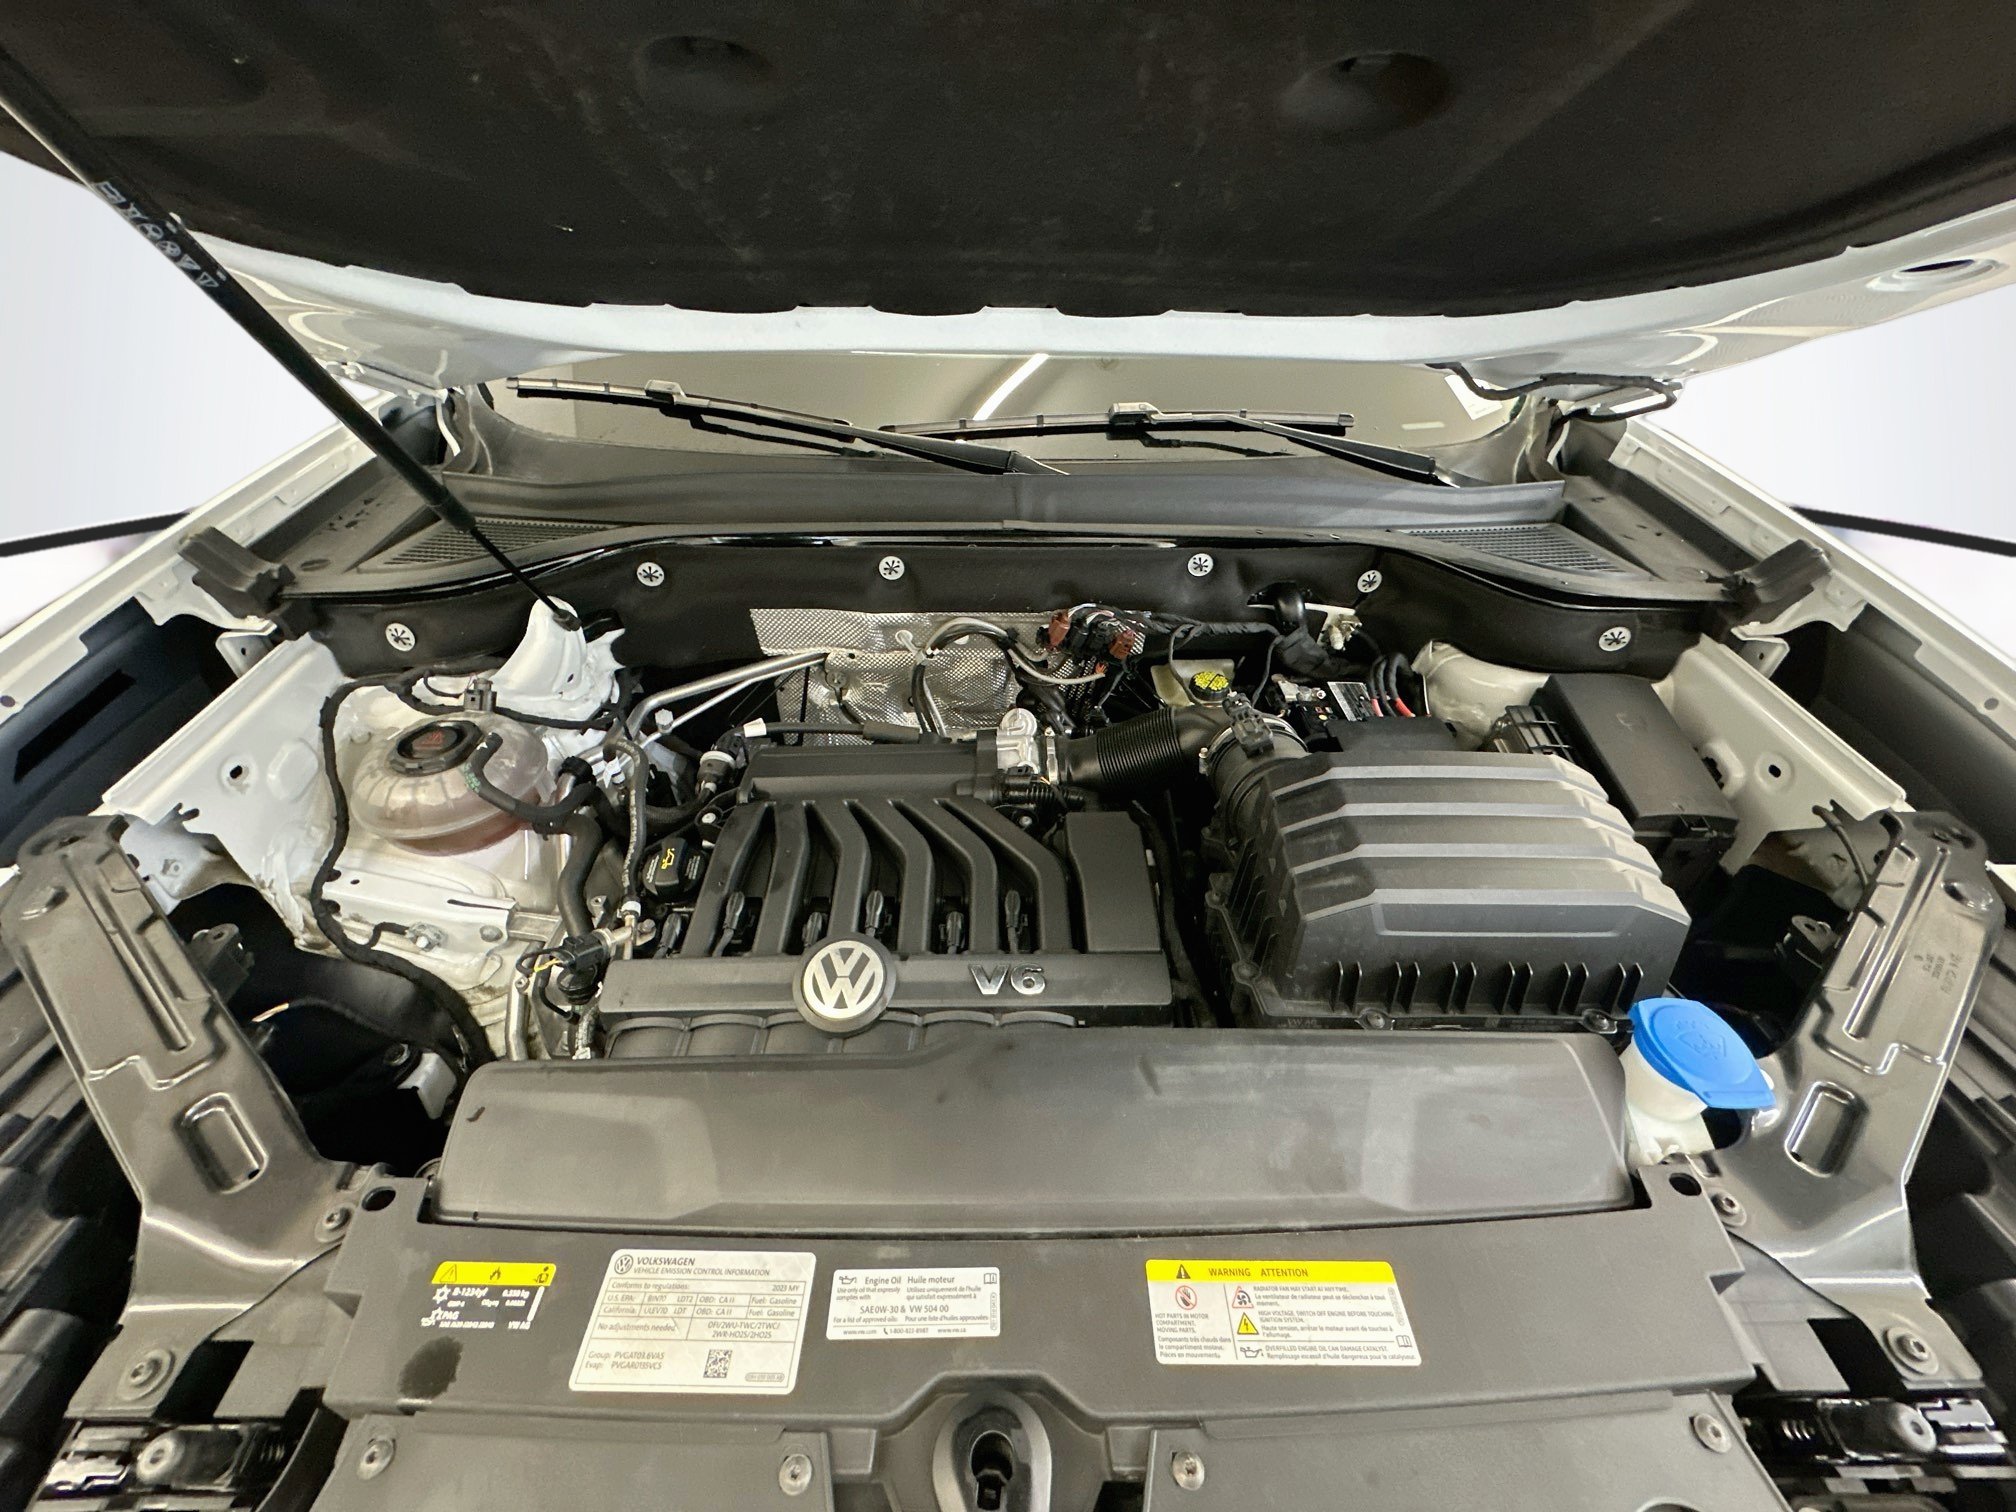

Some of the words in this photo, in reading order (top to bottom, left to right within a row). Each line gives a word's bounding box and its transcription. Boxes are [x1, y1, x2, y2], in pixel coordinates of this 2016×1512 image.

[803, 940, 884, 1019] VW
[968, 962, 1046, 995] V6
[637, 1257, 696, 1266] VOLKSWAGEN
[661, 1267, 691, 1275] EMISSION
[1208, 1267, 1251, 1277] WARNING
[1261, 1268, 1309, 1277] ATTENTION
[865, 1276, 889, 1286] Engine
[891, 1276, 901, 1284] Oil
[907, 1276, 927, 1284] Huile
[928, 1276, 955, 1284] moteur
[612, 1281, 642, 1289] Conforms
[652, 1282, 690, 1291] regulations:
[767, 1309, 795, 1317] Gasoline
[900, 1305, 906, 1313] &
[909, 1305, 922, 1313] VW
[924, 1305, 938, 1313] 504
[939, 1304, 949, 1313] 00
[609, 1323, 650, 1332] adjustments
